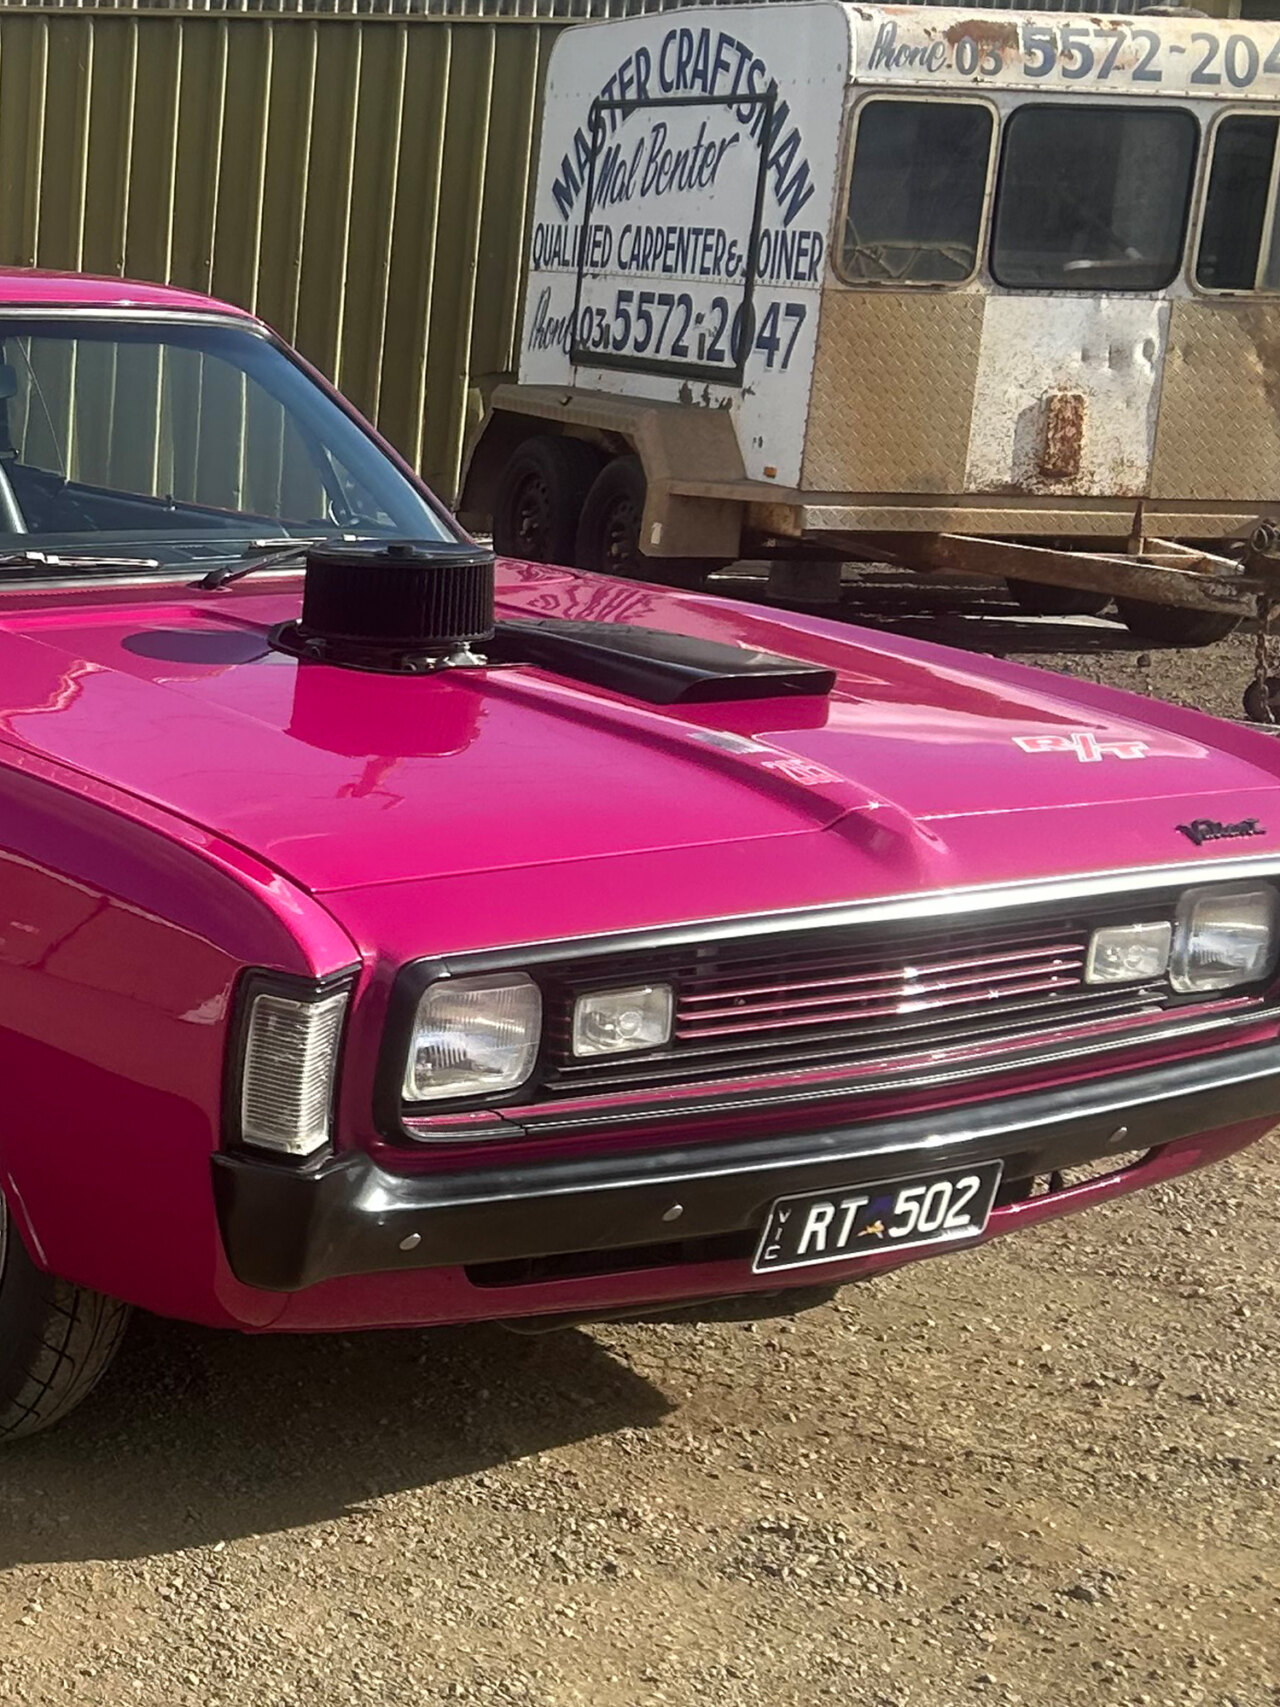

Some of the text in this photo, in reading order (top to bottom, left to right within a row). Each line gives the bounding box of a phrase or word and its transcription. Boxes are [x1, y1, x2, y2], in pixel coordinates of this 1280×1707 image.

[868, 20, 947, 73] Phone
[955, 36, 1003, 76] 03
[551, 27, 816, 228] MASTER CRAFTSMAN
[590, 121, 740, 213] Mal Benter
[532, 222, 613, 271] QUALIIED
[740, 228, 824, 282] OINER
[1011, 732, 1150, 763] R/T
[764, 1208, 792, 1261] VIC
[796, 1175, 981, 1255] RT 502
